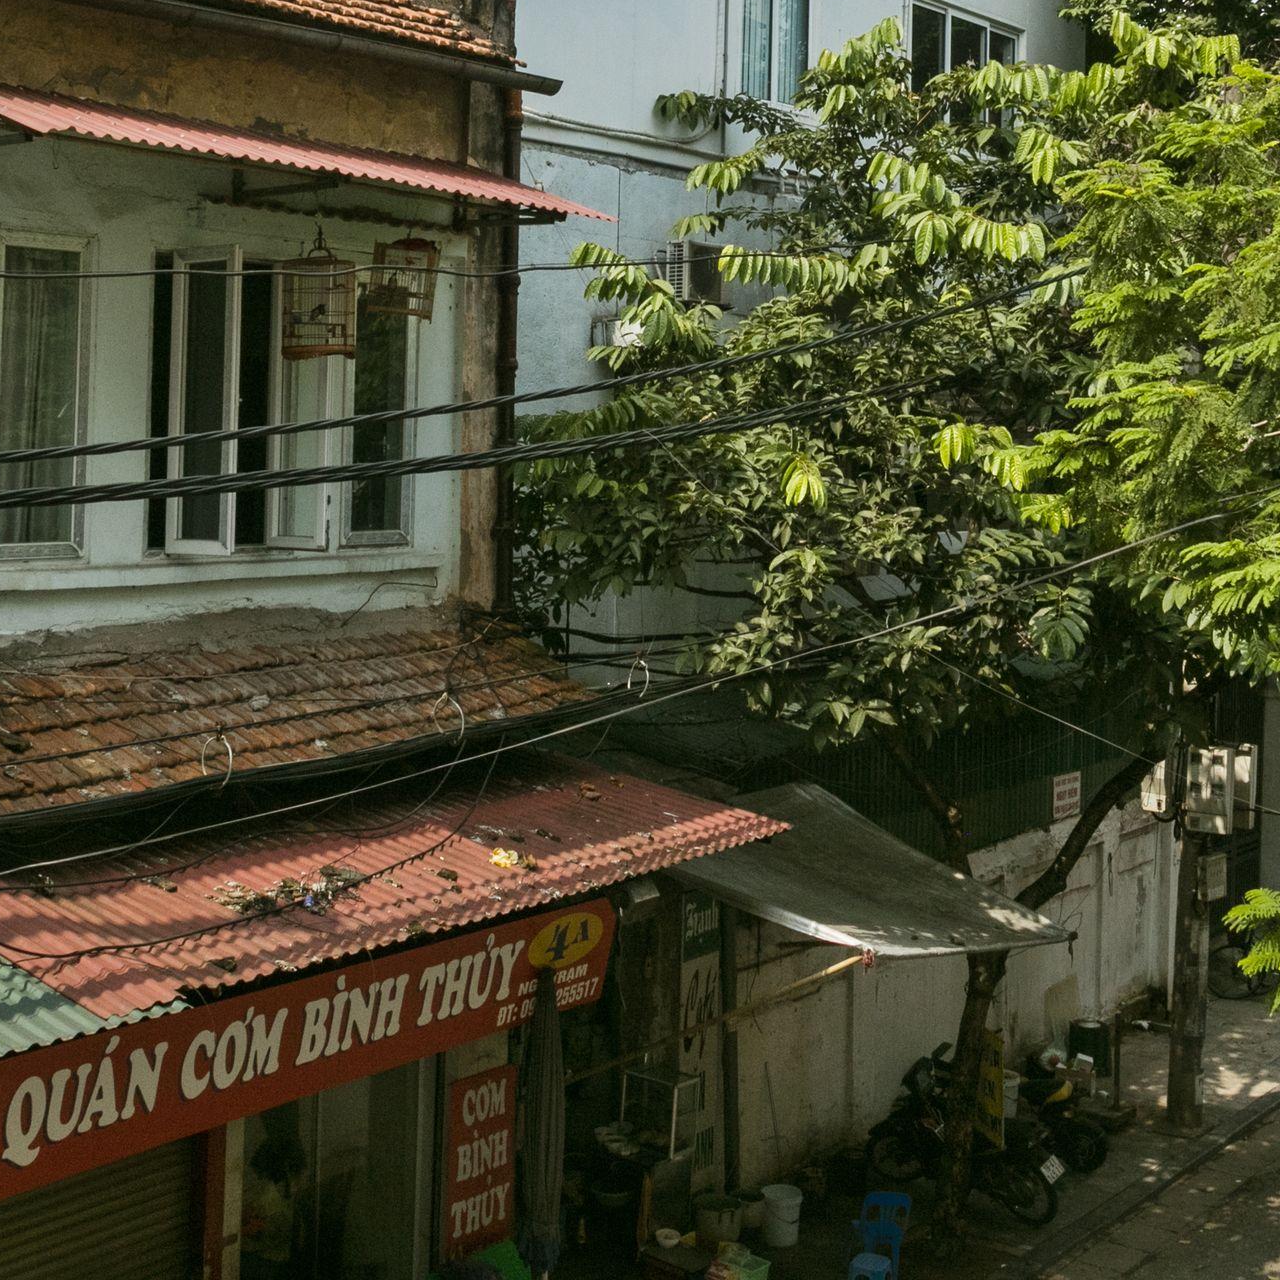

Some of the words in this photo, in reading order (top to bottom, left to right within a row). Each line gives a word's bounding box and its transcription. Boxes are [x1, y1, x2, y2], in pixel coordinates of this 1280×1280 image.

[2, 1035, 168, 1166] QUÁN
[181, 1007, 288, 1100] CƠM
[295, 974, 410, 1066] BÌNH
[417, 933, 525, 1027] THỦY
[463, 1078, 507, 1126] CƠM
[456, 1129, 509, 1182] BÌNH
